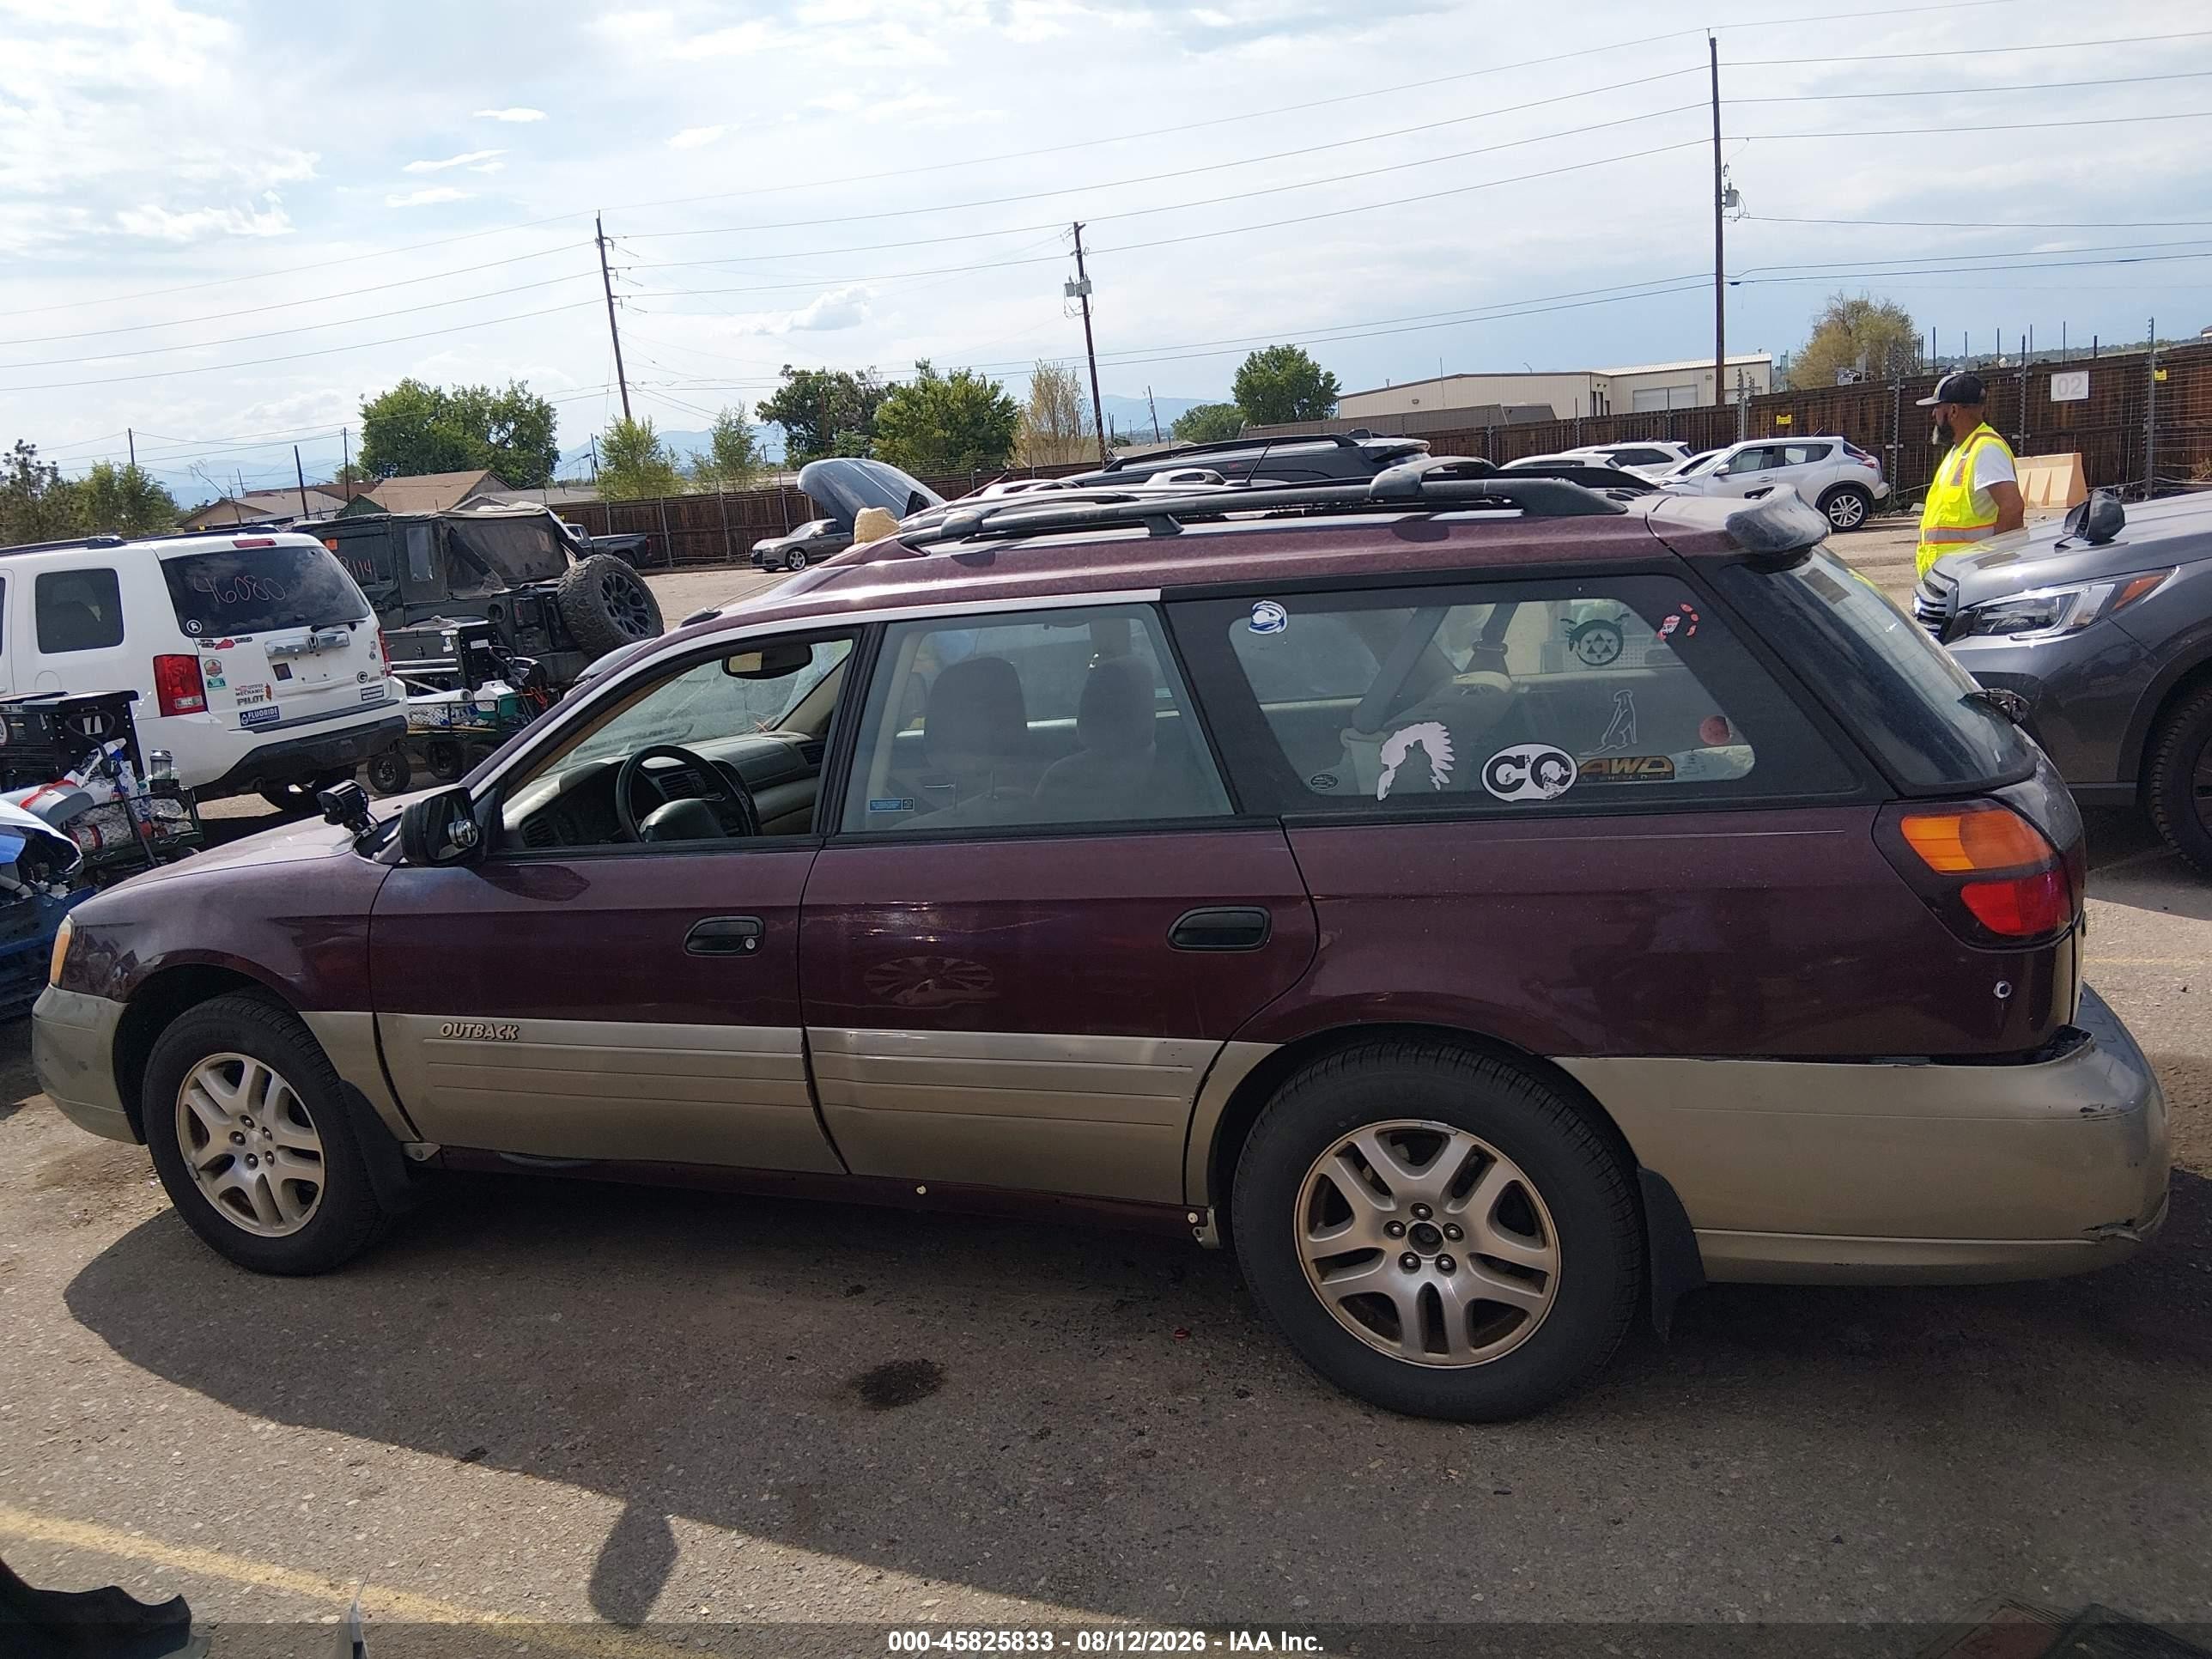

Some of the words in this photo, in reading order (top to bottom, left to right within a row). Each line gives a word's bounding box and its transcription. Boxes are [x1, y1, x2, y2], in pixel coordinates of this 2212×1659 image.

[2057, 376, 2082, 397] 02
[193, 574, 286, 605] 46080
[237, 694, 264, 706] PILOT
[247, 707, 278, 719] FLUORIDE
[1486, 752, 1571, 793] CO
[1579, 756, 1674, 775] AWD
[440, 1022, 520, 1040] OUTBACK
